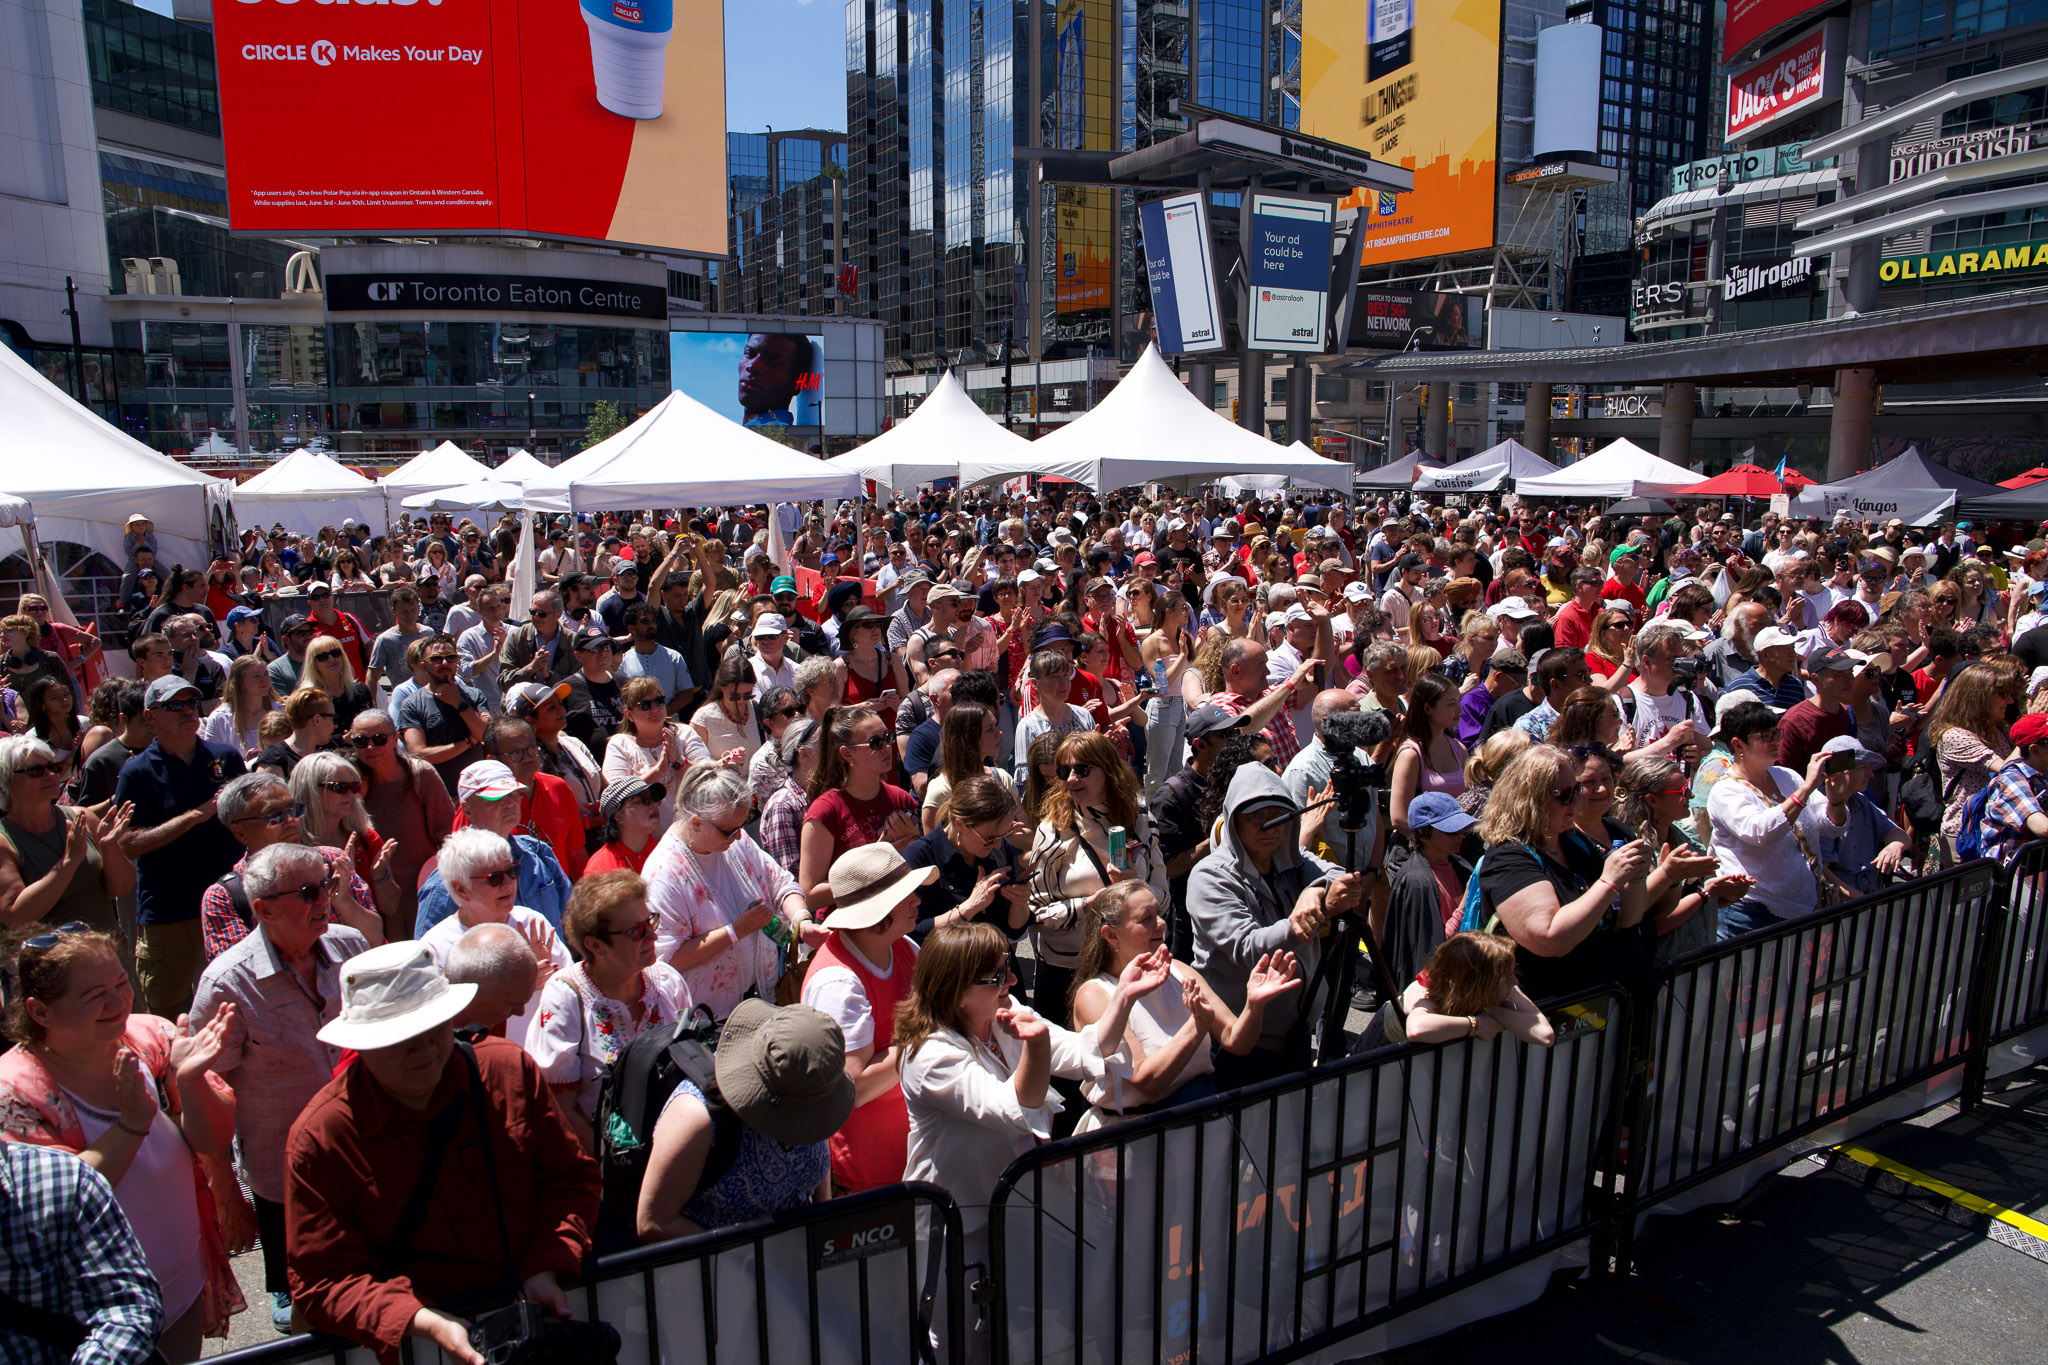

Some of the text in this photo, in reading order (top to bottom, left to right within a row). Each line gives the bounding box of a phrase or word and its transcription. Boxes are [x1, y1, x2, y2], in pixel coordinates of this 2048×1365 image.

[616, 7, 632, 17] CIRCLE
[242, 43, 482, 65] CIRCLE K Makes Your Day
[1797, 45, 1820, 67] PARTY
[1798, 62, 1813, 80] THIS
[1731, 58, 1796, 127] JACK'S
[1797, 76, 1812, 94] WAY
[1891, 127, 2006, 157] UNGE RESTAURANT
[1294, 143, 1368, 173] sankofa square
[1507, 164, 1564, 183] brandedcities
[1381, 205, 1395, 215] RBC
[1367, 216, 1414, 231] MPHITHEATRE
[1265, 231, 1300, 245] Your ad
[1366, 227, 1450, 249] AT RBCAMPHITHEATRE.COM
[1264, 246, 1303, 259] could be
[1157, 257, 1166, 267] ad
[1263, 259, 1285, 271] here
[1879, 243, 2048, 282] OLLARAMA
[1162, 270, 1170, 280] be
[1725, 256, 1812, 300] ballroom
[1730, 265, 1748, 280] The
[1781, 275, 1806, 289] BOWL
[368, 282, 641, 310] CF Toronto Eaton Centre
[1271, 294, 1304, 302] @astralooh
[1368, 294, 1385, 302] SWITCH
[1392, 296, 1412, 304] CANADA'S
[1632, 281, 1682, 309] ERS
[1368, 302, 1407, 317] BEST 5G+
[1367, 316, 1411, 331] NETWORK
[1192, 328, 1210, 338] astral
[1292, 328, 1313, 337] astral
[796, 372, 821, 391] H&M
[1366, 427, 1376, 435] fido
[1435, 478, 1473, 488] Cuisine
[1852, 497, 1898, 515] Lángos
[1658, 715, 1680, 724] STRONG
